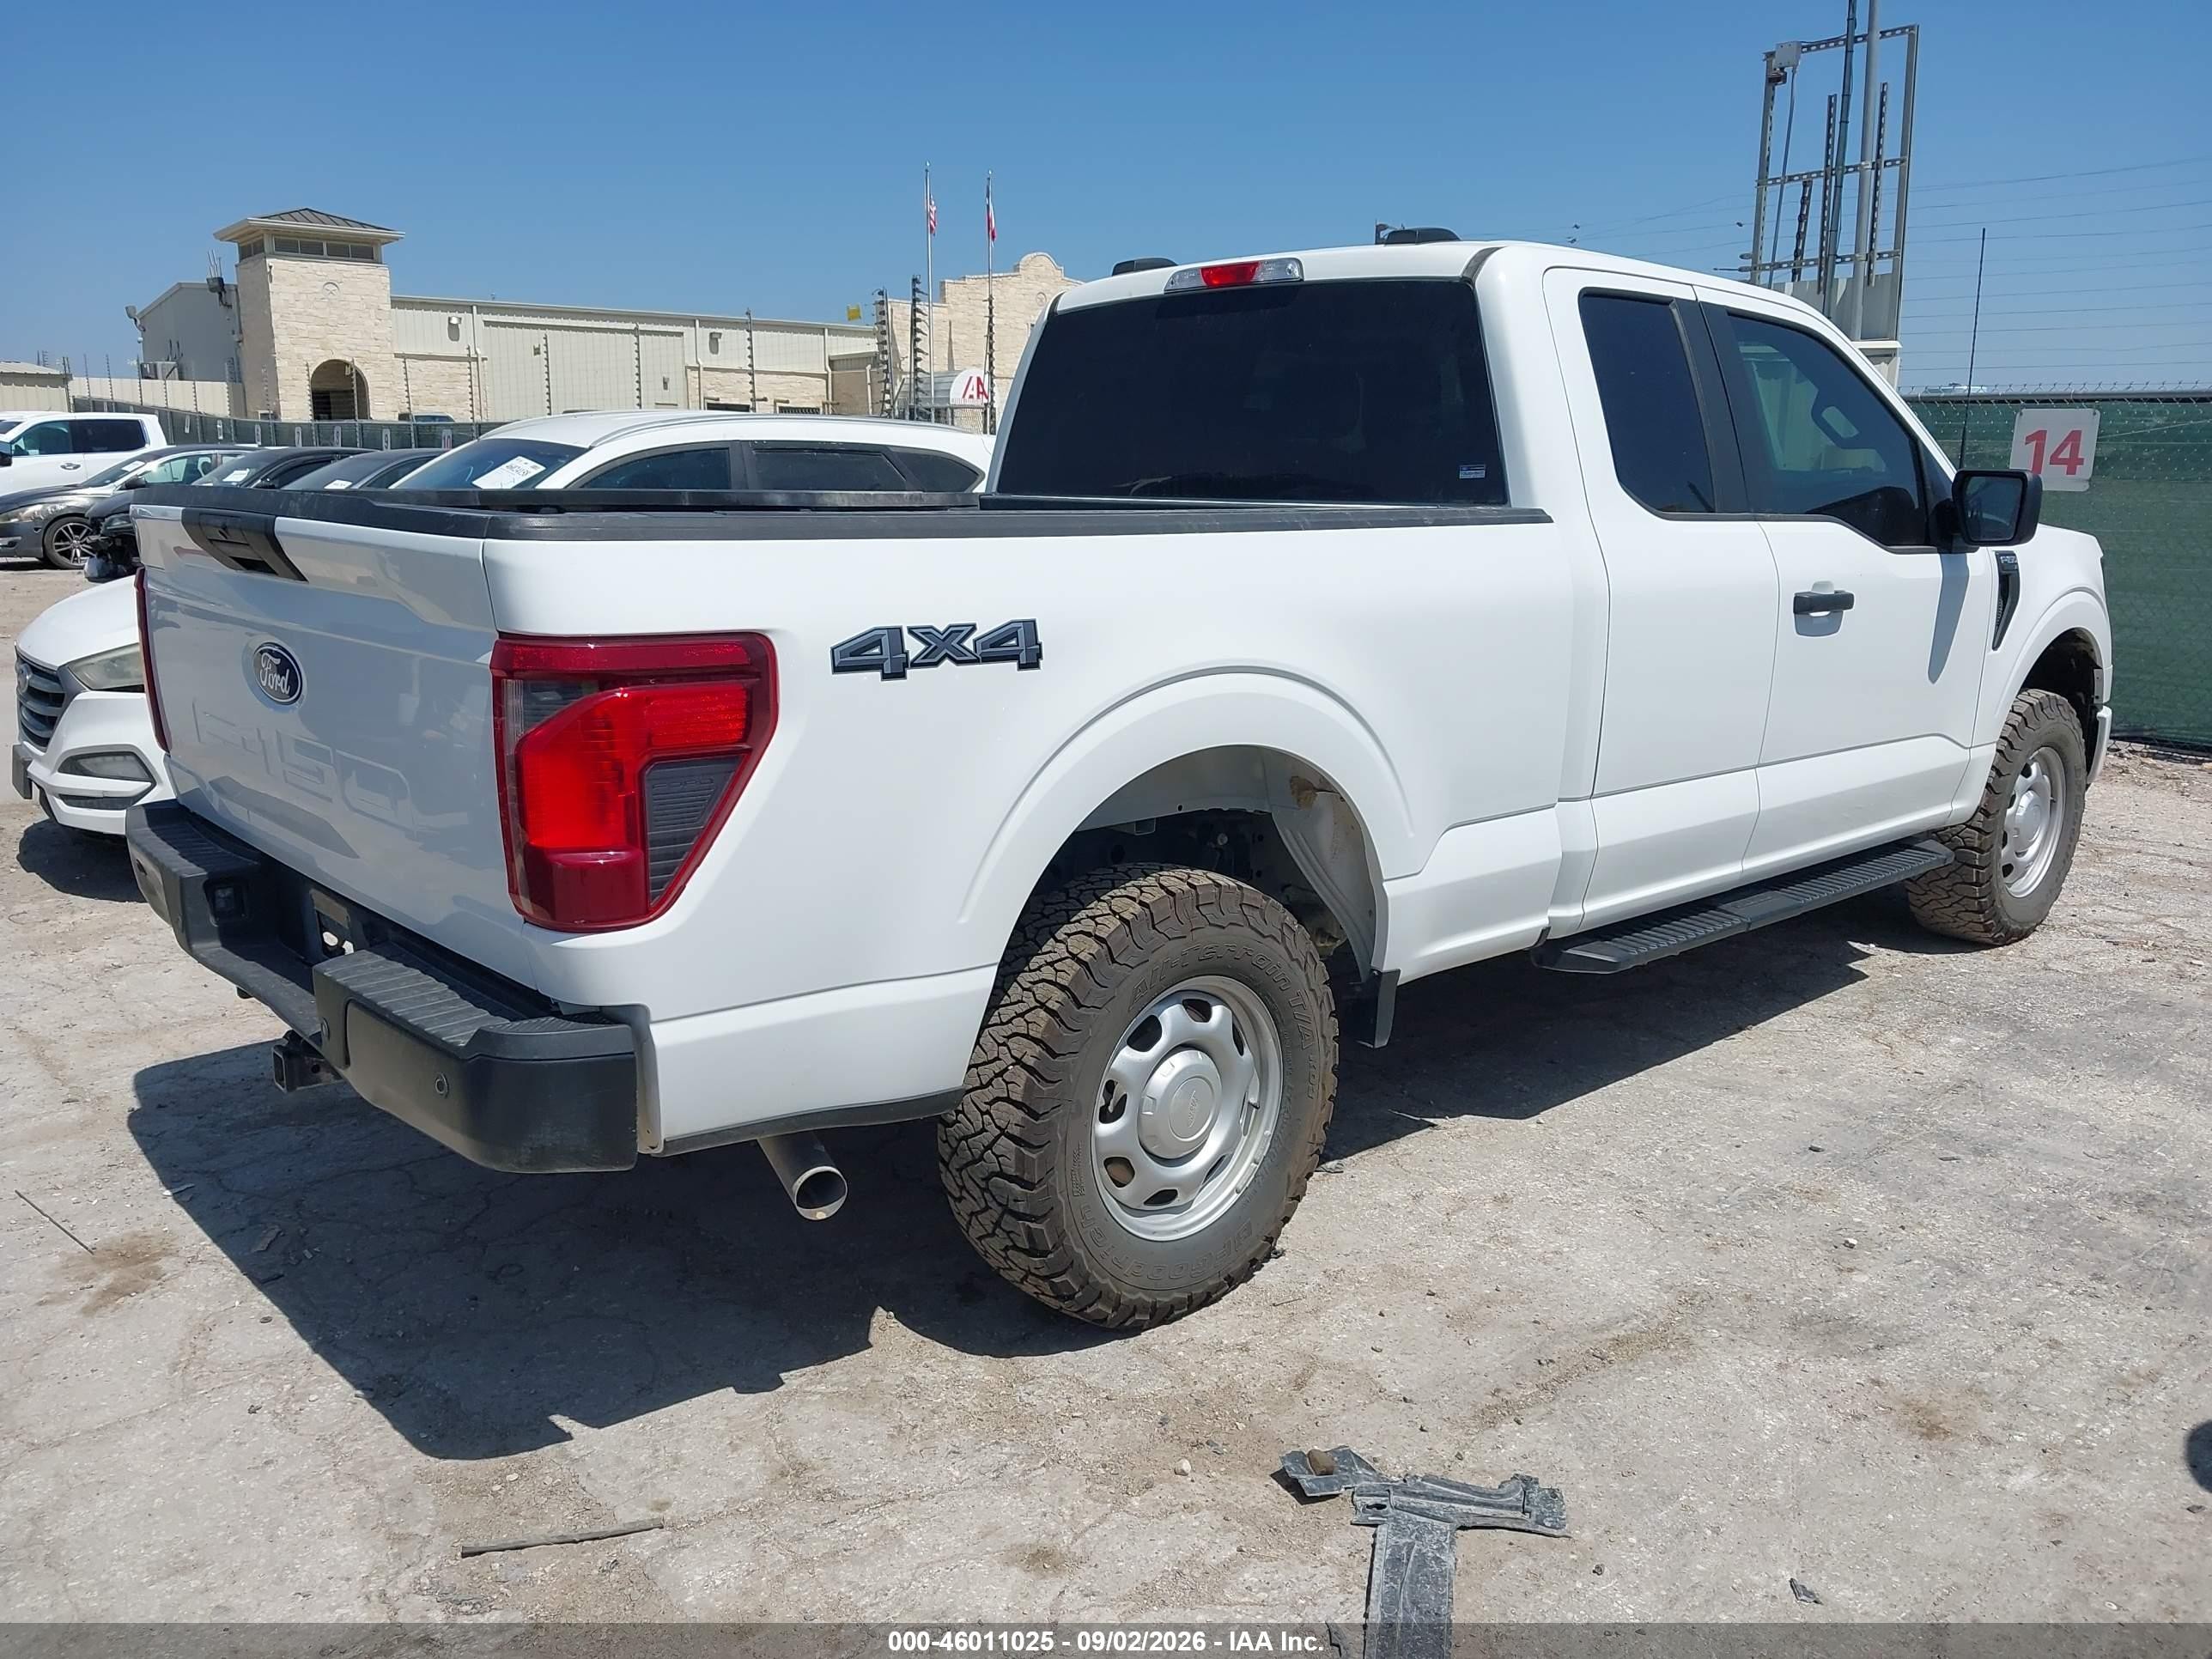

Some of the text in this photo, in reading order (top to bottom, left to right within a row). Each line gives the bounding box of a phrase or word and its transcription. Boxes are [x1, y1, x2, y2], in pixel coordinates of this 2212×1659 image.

[2025, 430, 2085, 475] 14
[260, 653, 290, 695] Ford
[1128, 944, 1291, 1012] All-Terrain
[1288, 988, 1314, 1050] T/A
